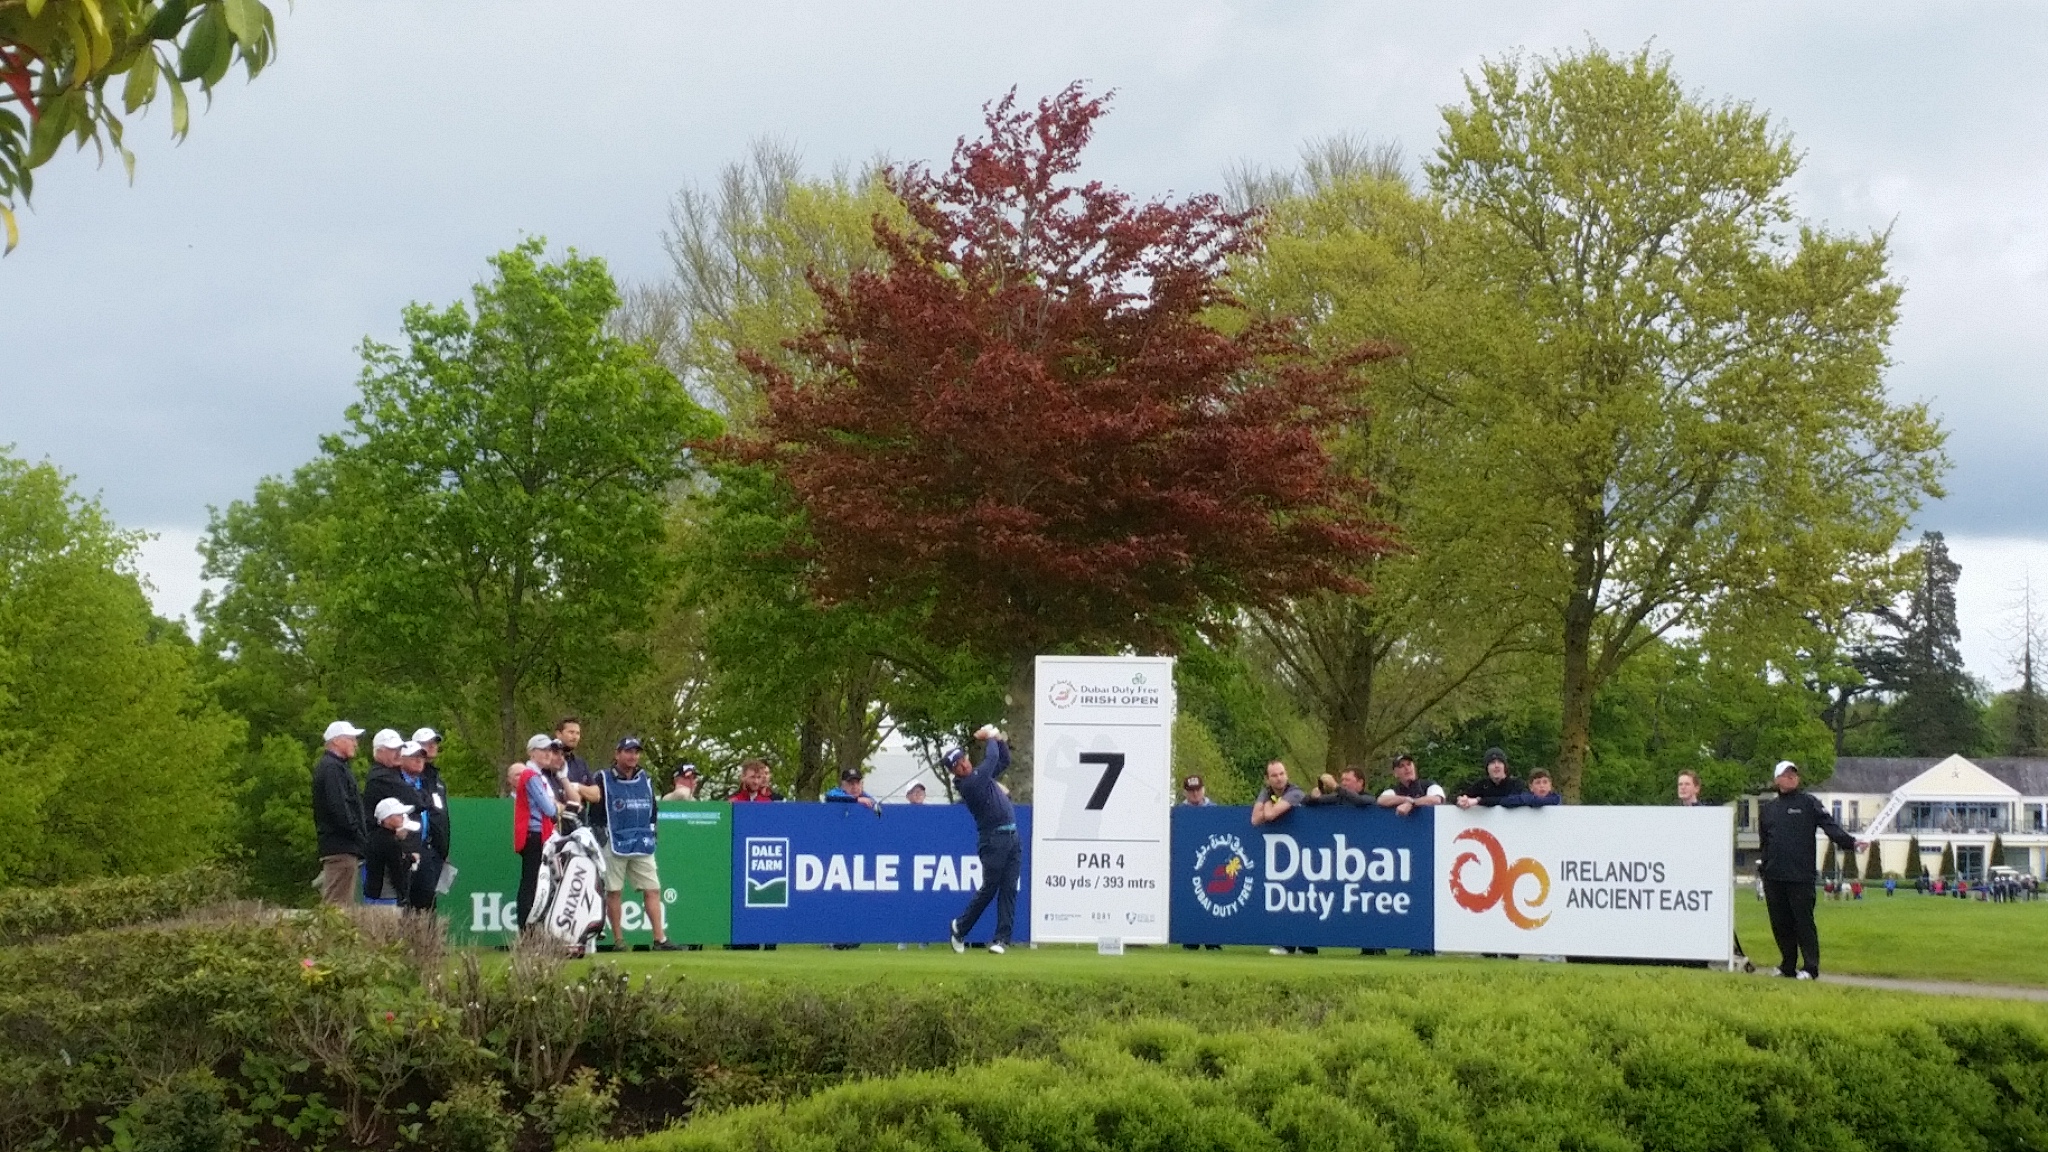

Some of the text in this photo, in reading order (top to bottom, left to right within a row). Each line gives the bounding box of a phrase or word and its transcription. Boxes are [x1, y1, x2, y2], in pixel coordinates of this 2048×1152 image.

[1080, 695, 1116, 704] IRISH
[1121, 695, 1159, 705] OPEN
[1081, 685, 1109, 694] Dubai
[1112, 685, 1134, 695] Duty
[1138, 685, 1159, 694] Free
[1079, 752, 1125, 811] 7
[752, 845, 782, 857] DALE
[1077, 853, 1125, 869] PAR 4
[1262, 833, 1411, 882] Dubai
[752, 859, 783, 871] FARM
[795, 855, 1020, 891] DALE FAR
[1561, 860, 1665, 883] IRELAND'S
[1045, 875, 1066, 888] 430
[1070, 875, 1091, 890] yds
[1102, 876, 1124, 888] 393
[1127, 877, 1155, 889] mtrs
[556, 865, 587, 931] SRIXON
[1192, 876, 1254, 917] DUBAI DUTY FREE
[1264, 882, 1411, 920] Duty Free
[1566, 887, 1713, 911] ANCIENT EAST
